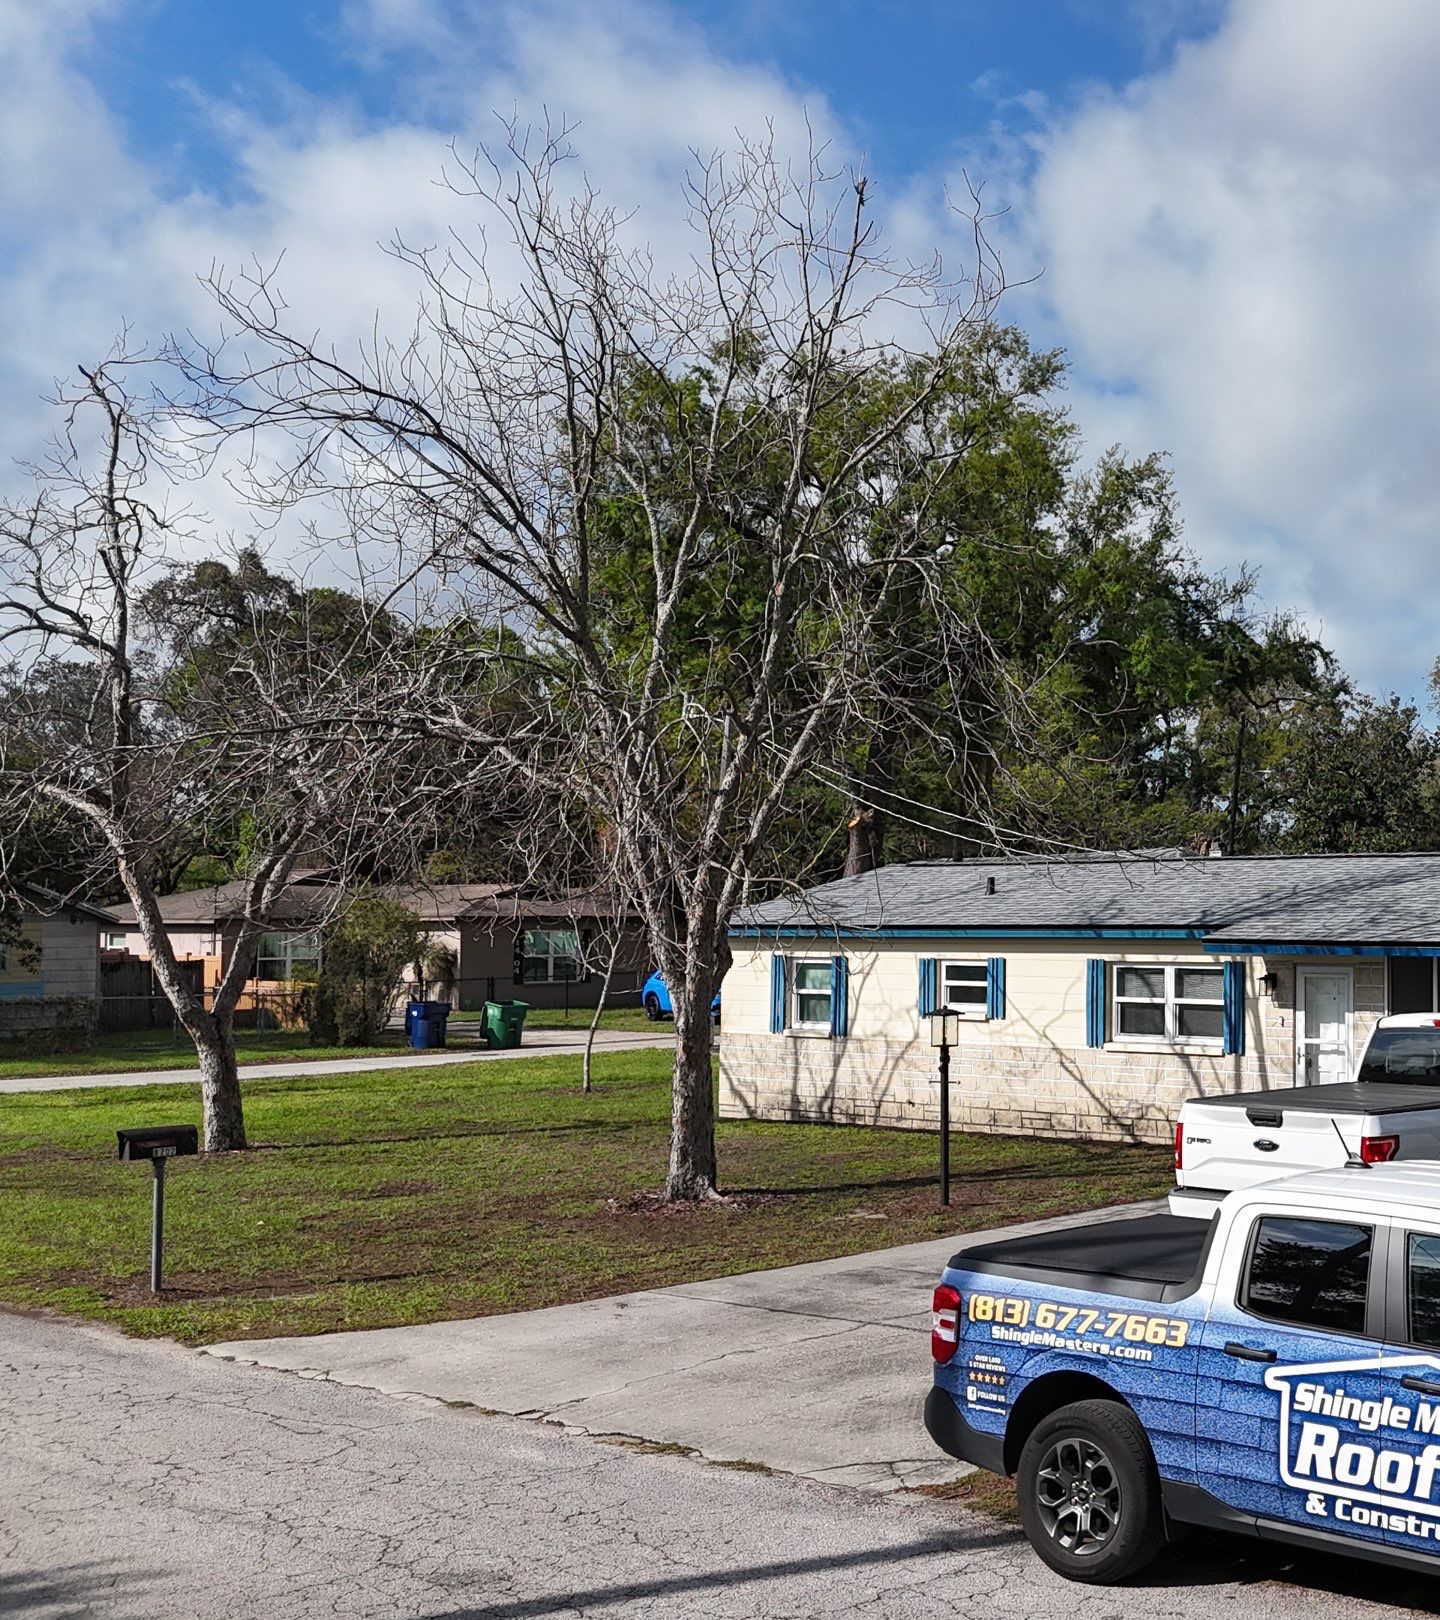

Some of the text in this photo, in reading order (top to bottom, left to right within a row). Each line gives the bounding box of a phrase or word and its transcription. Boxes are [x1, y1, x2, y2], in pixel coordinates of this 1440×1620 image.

[968, 1294, 1189, 1348] (813) 677-7663
[991, 1325, 1152, 1361] ShingleMasters.com
[977, 1390, 1006, 1402] FOLLOW US
[1293, 1383, 1411, 1432] Shingle
[1305, 1492, 1328, 1517] &
